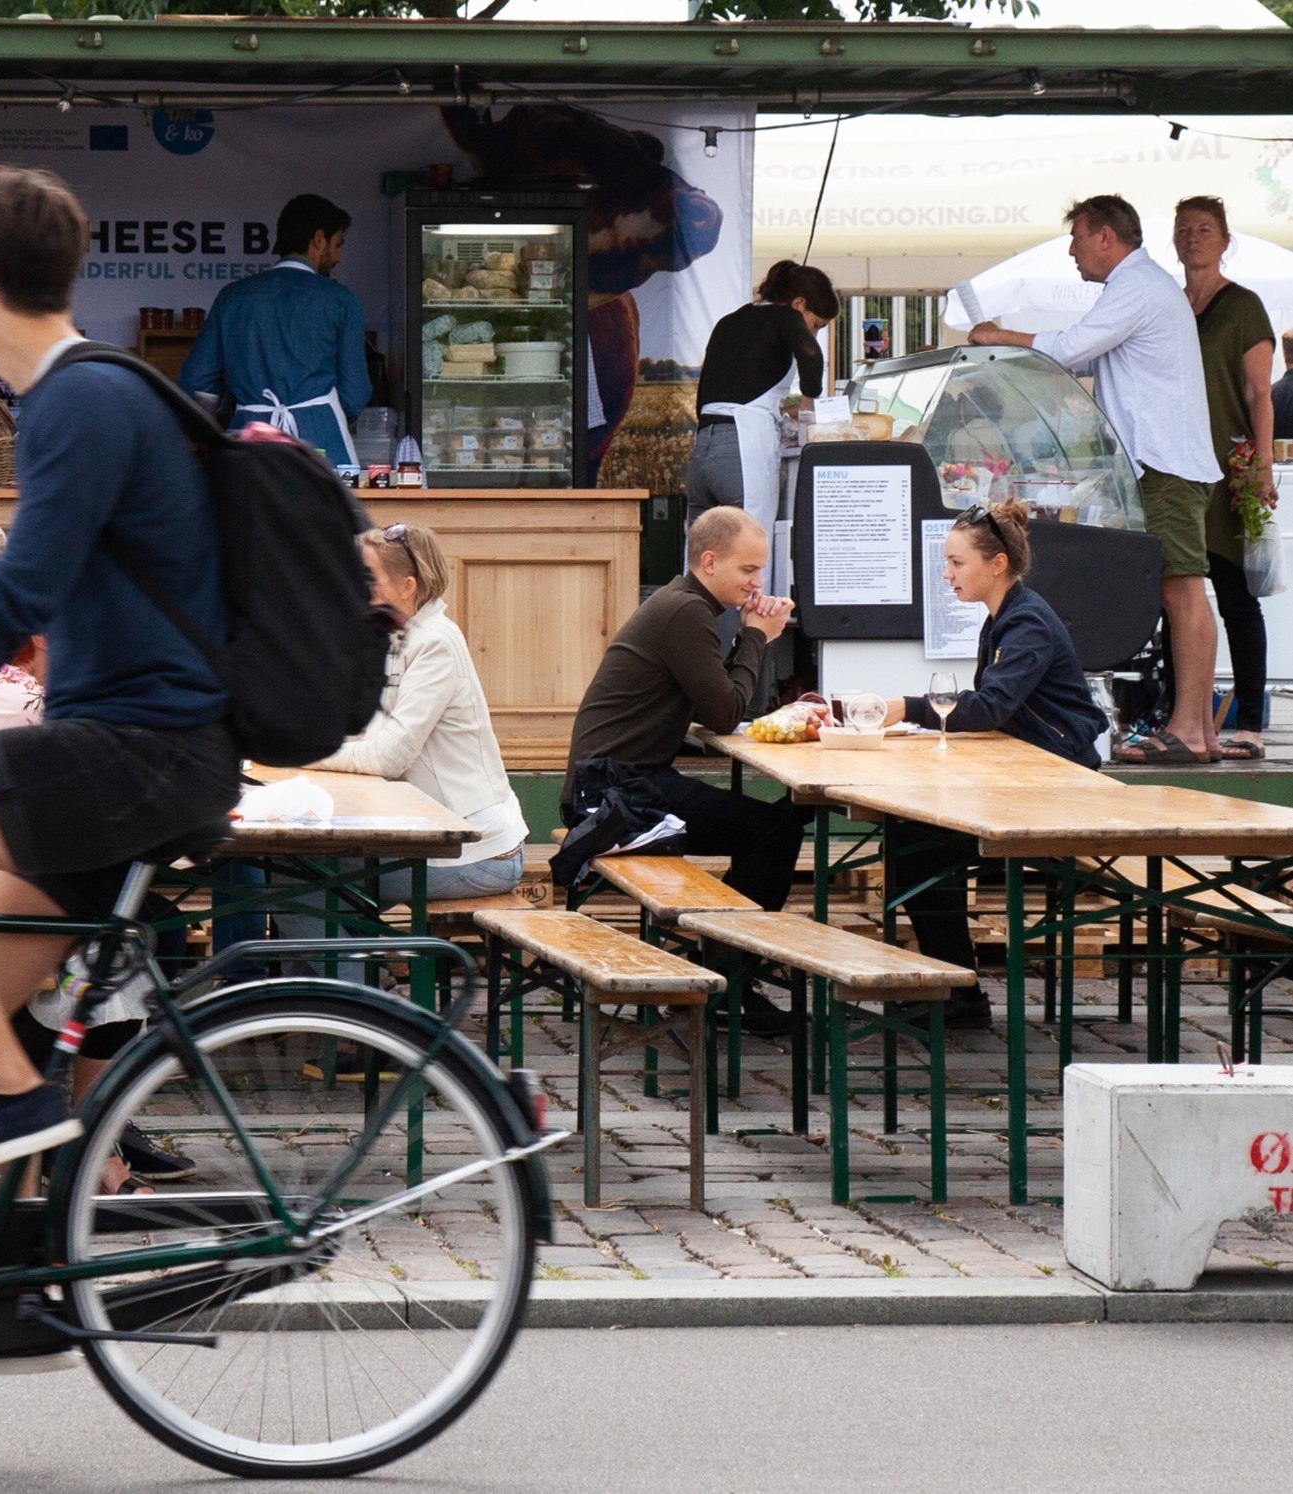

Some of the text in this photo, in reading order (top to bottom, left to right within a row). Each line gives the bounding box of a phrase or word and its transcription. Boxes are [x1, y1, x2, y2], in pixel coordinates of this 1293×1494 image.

[165, 123, 204, 141] & ko
[88, 220, 226, 254] HEESE
[81, 262, 174, 279] DERFUL
[817, 470, 848, 479] MENU
[1249, 1131, 1293, 1175] Ø
